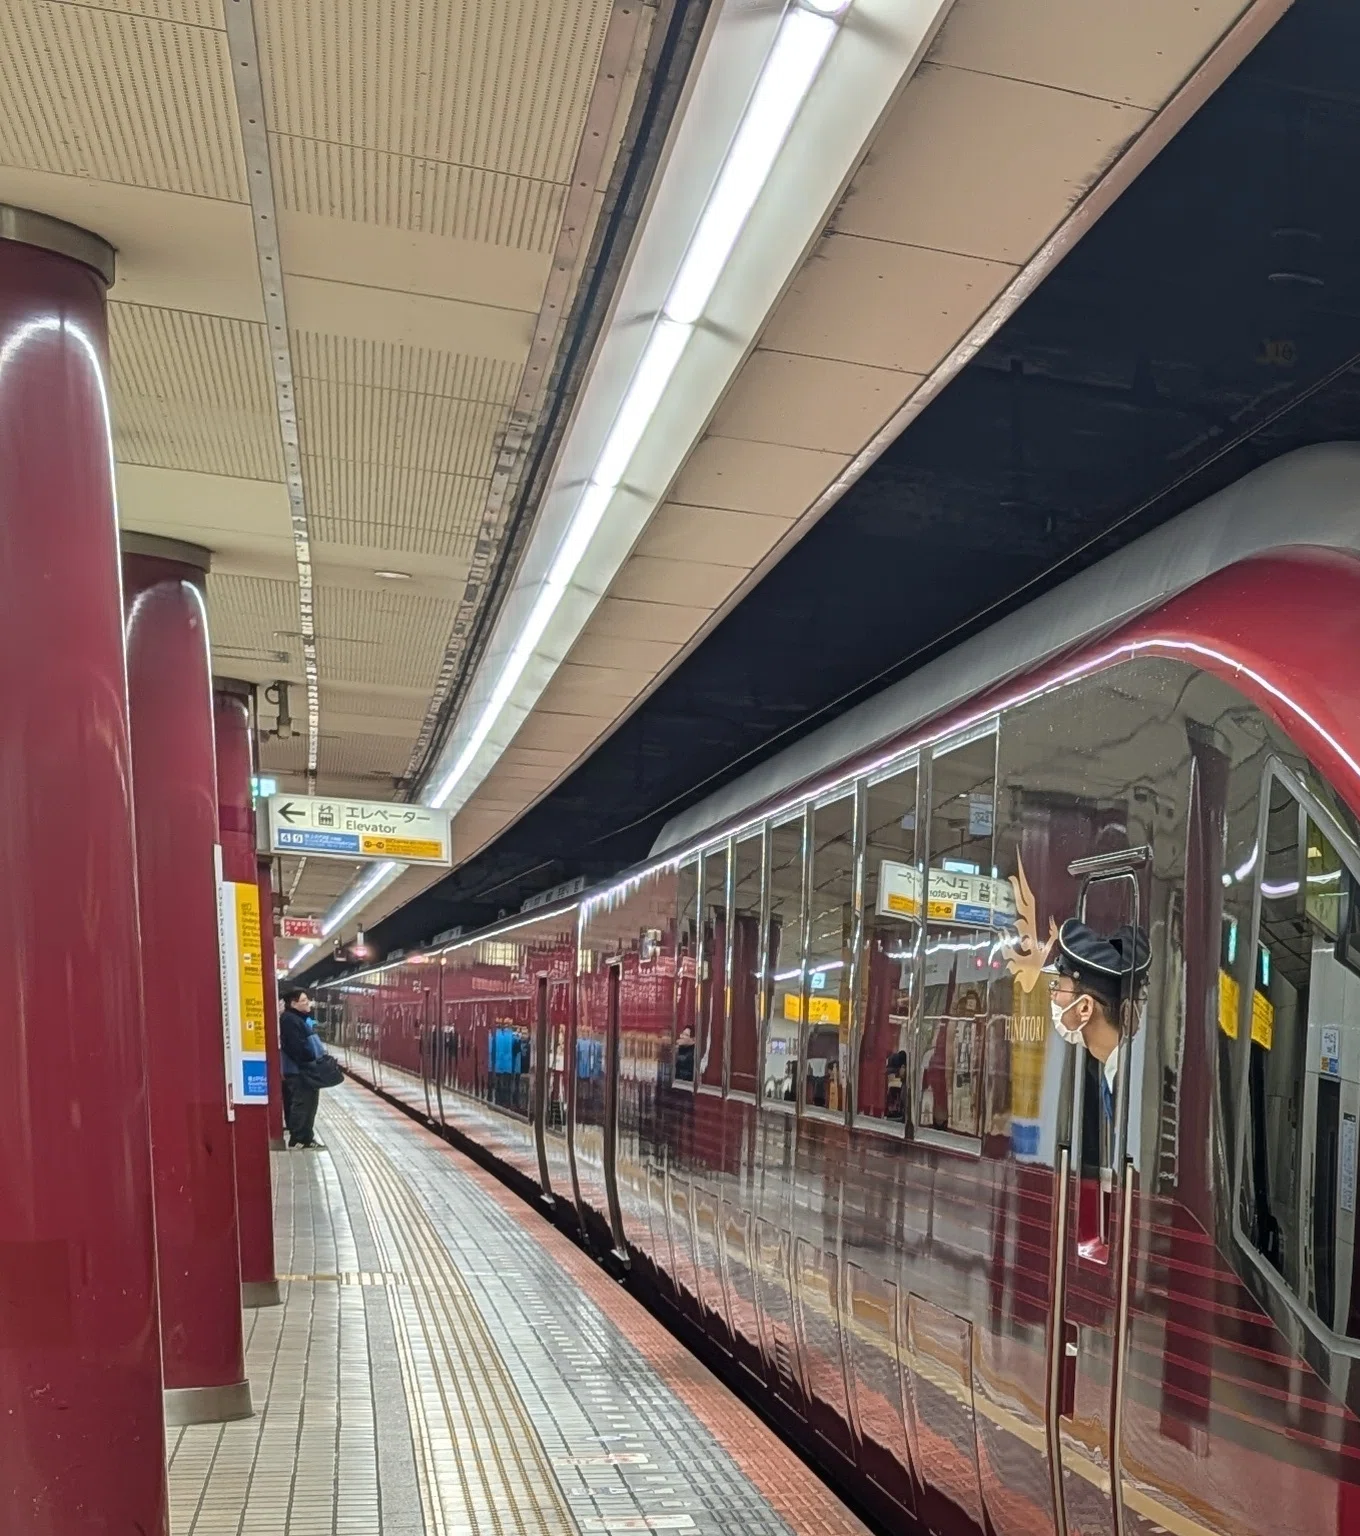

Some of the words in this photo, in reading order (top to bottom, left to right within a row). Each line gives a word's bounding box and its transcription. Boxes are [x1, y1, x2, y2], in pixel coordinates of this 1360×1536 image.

[346, 806, 430, 824] エレベーター
[346, 820, 397, 834] Elevator
[1004, 1015, 1045, 1042] HINOTORI
